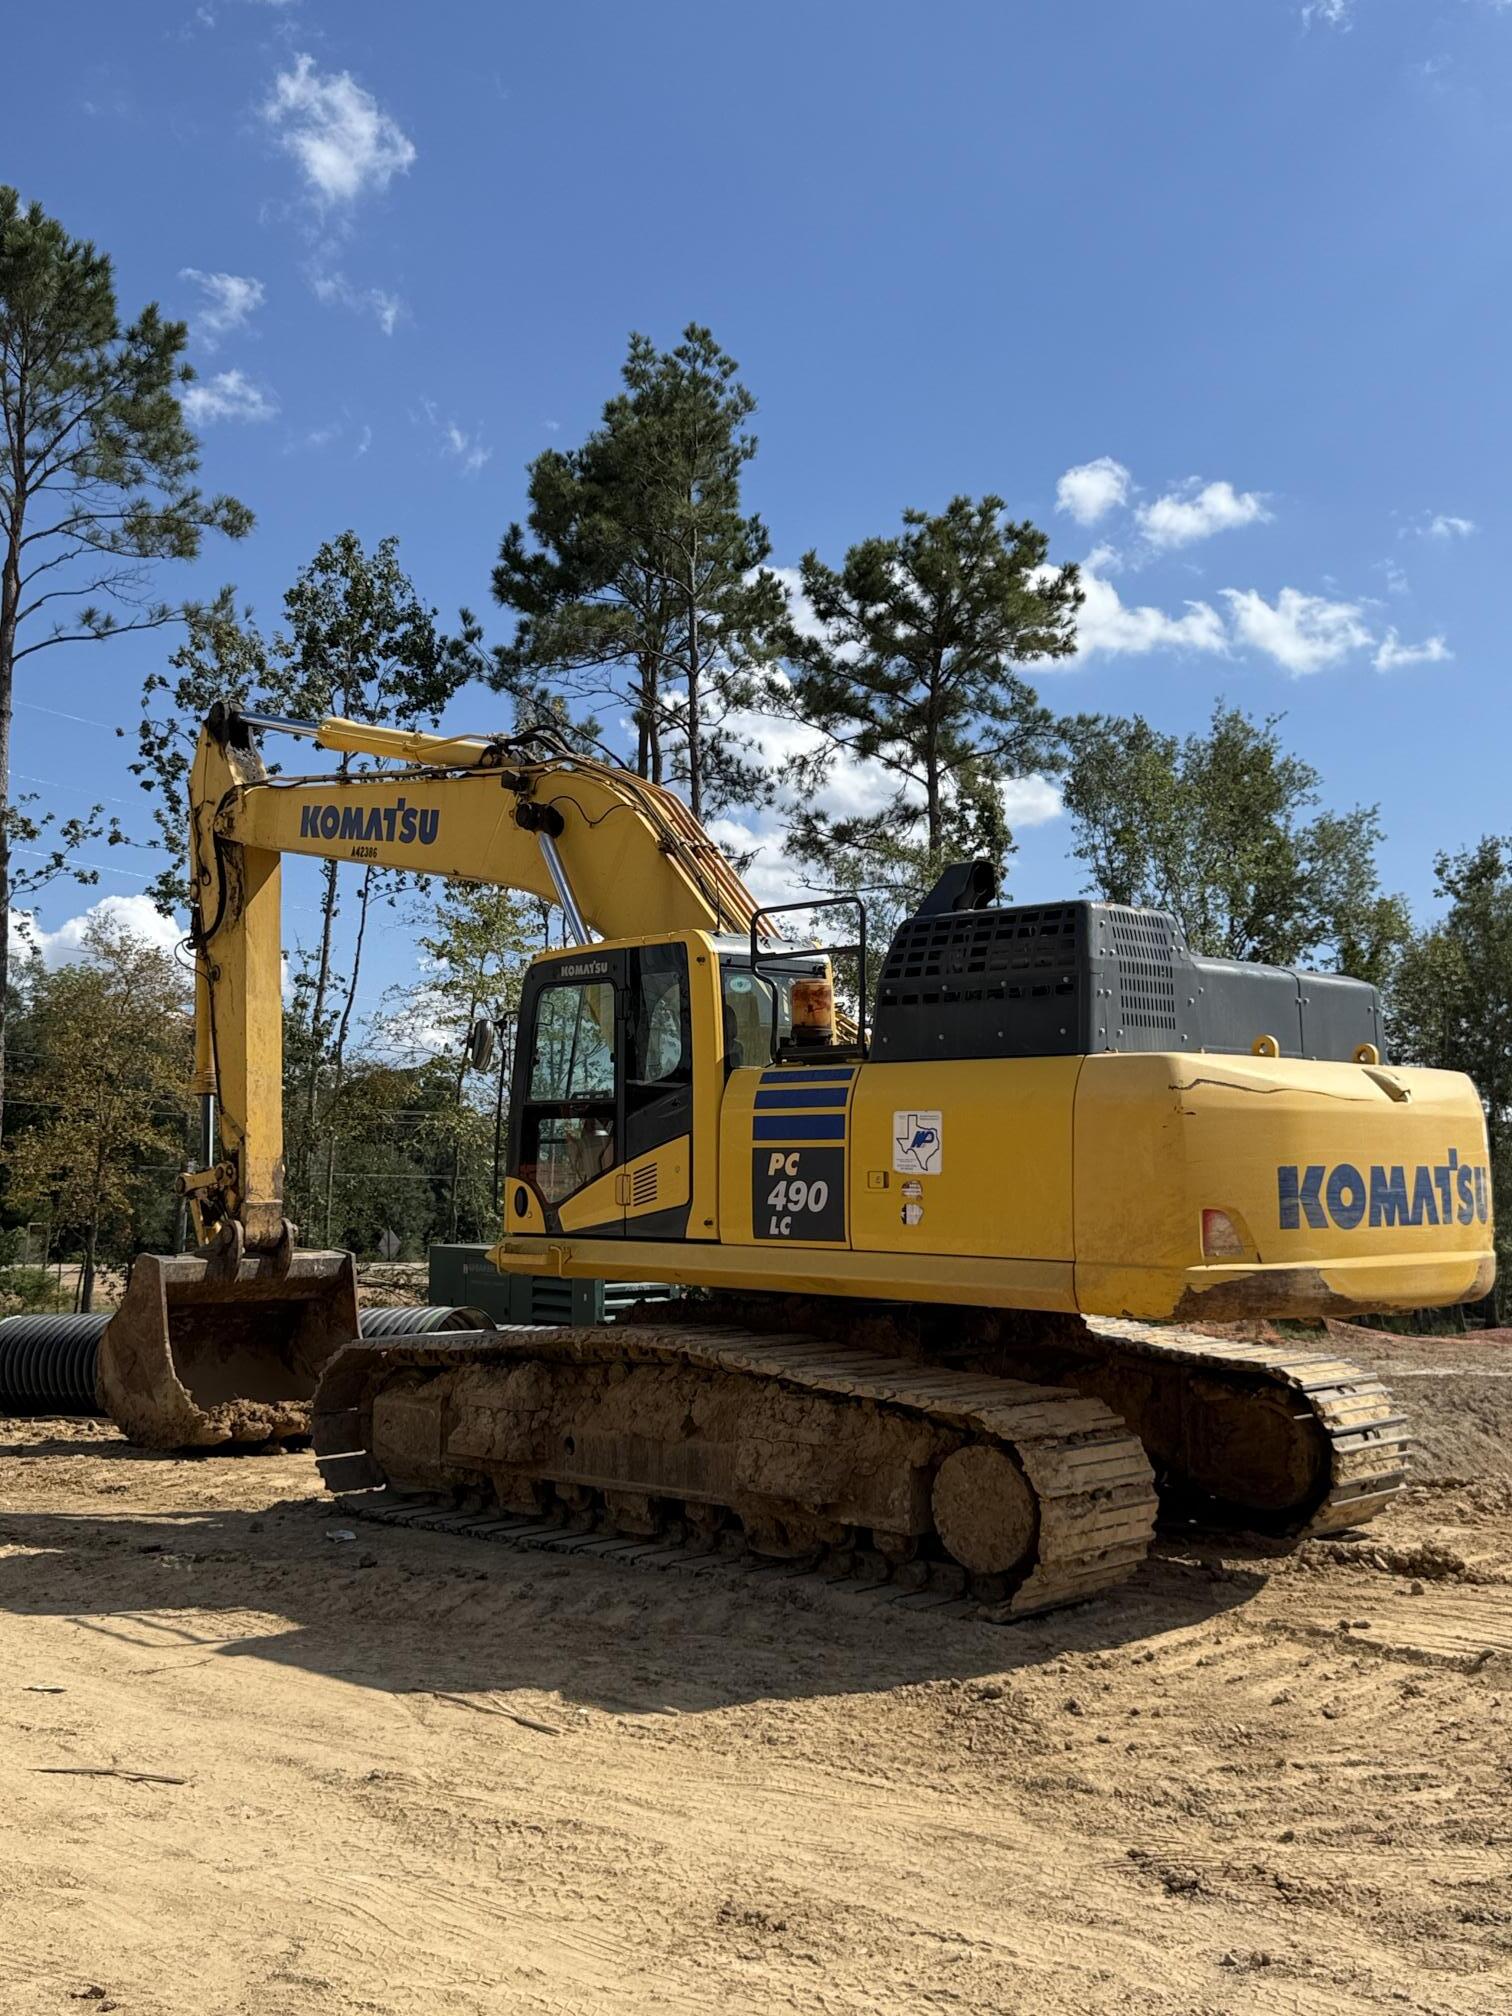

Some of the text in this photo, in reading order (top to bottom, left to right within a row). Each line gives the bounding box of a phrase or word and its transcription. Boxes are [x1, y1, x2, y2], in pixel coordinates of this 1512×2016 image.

[300, 797, 440, 845] KOMATSU
[561, 960, 608, 977] KOMATSU
[767, 1152, 801, 1176] PC
[767, 1180, 829, 1213] 490
[1277, 1148, 1488, 1230] KOMATSU
[769, 1215, 792, 1236] LC
